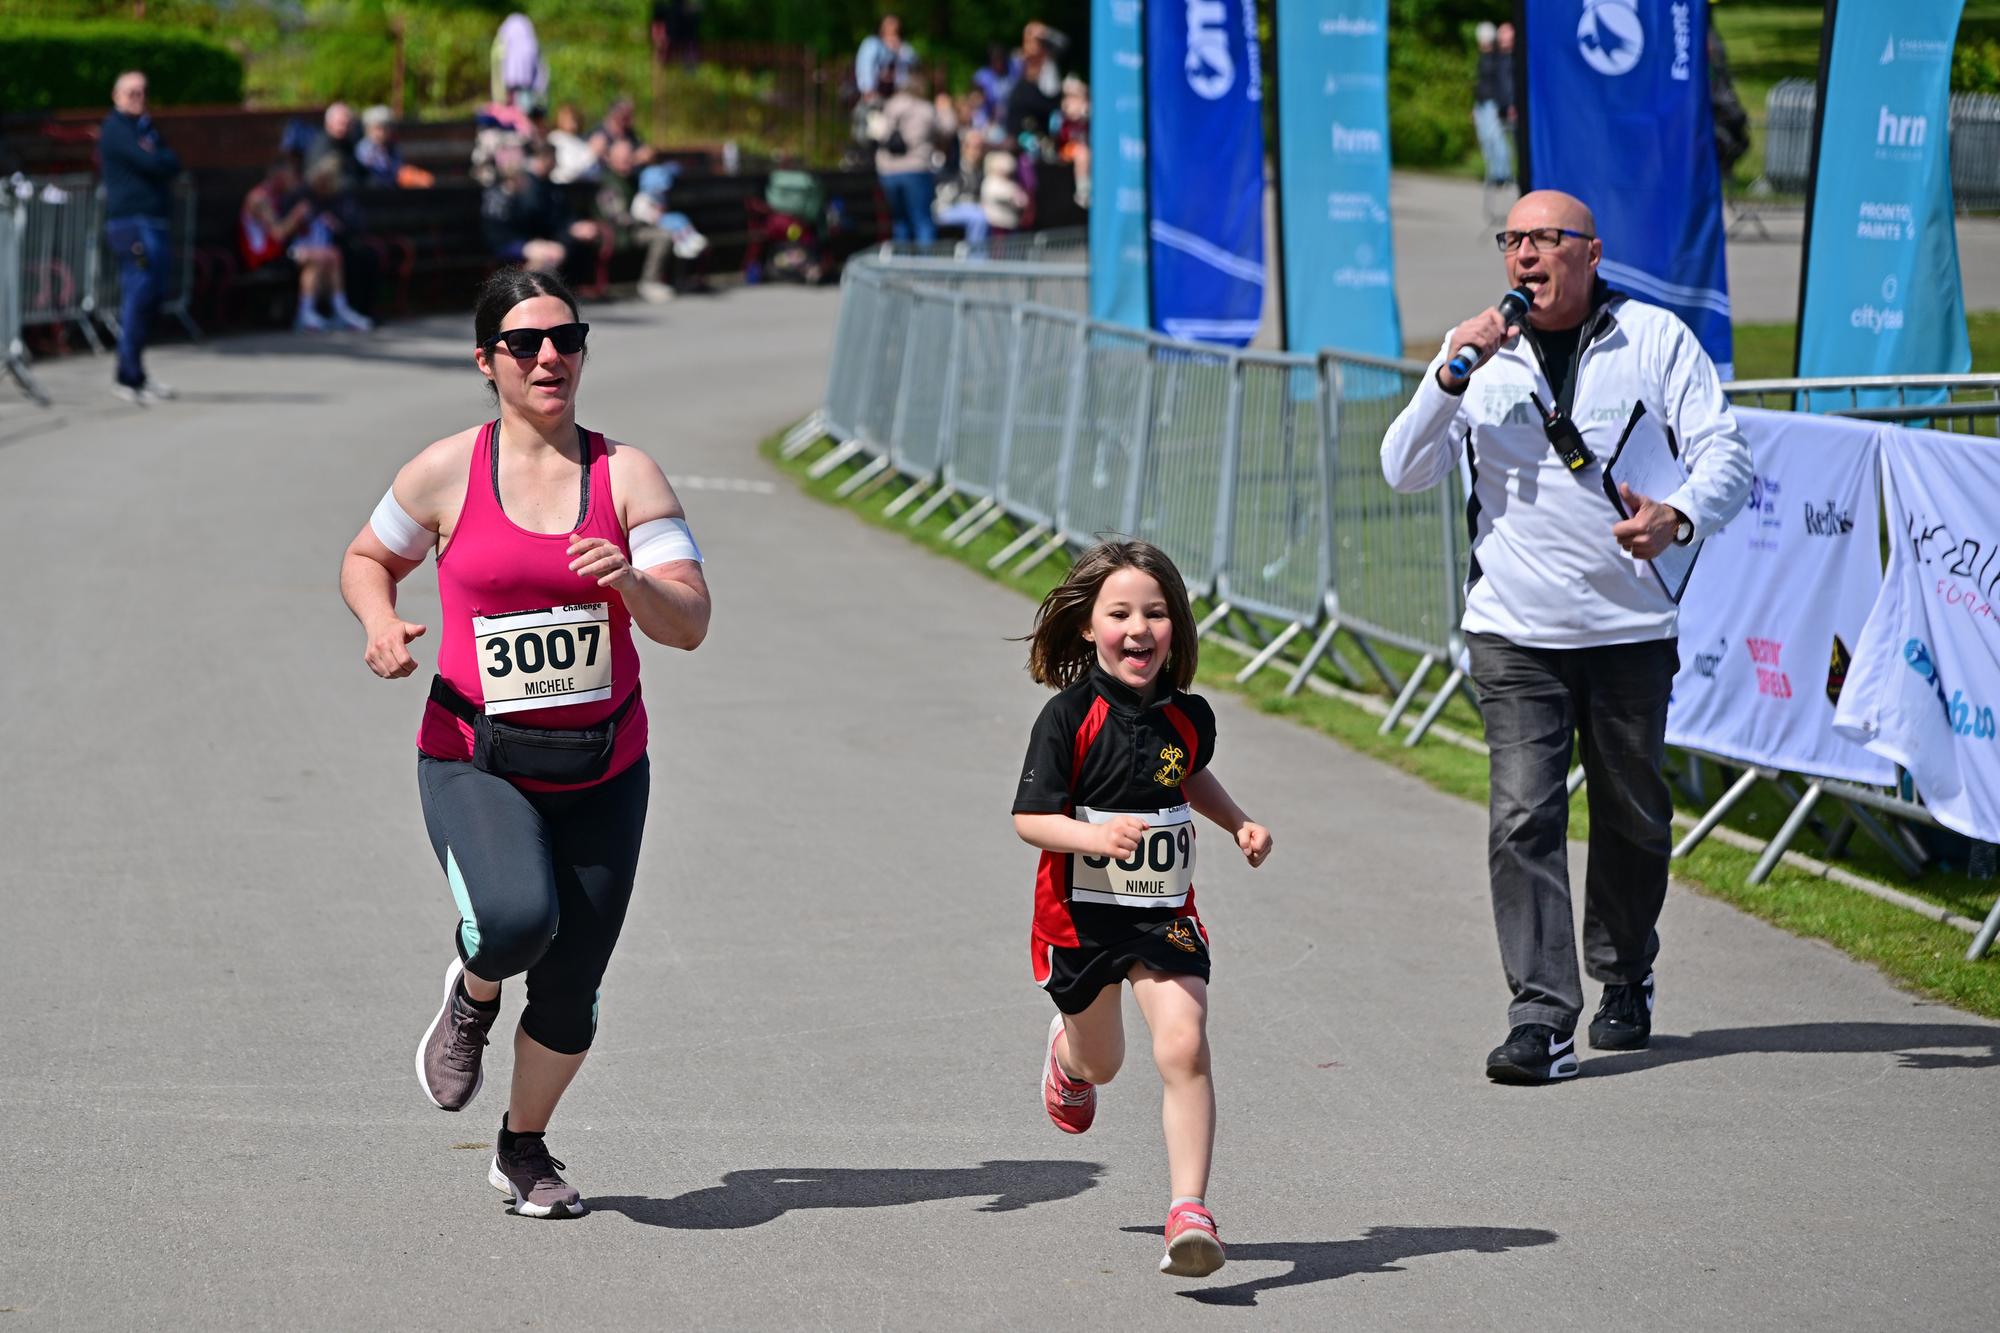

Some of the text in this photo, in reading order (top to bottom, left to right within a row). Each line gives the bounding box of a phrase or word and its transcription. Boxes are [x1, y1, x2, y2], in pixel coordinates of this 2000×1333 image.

[485, 625, 601, 678] 3007
[524, 677, 575, 696] MICHELE
[1125, 879, 1165, 894] NIMUE
